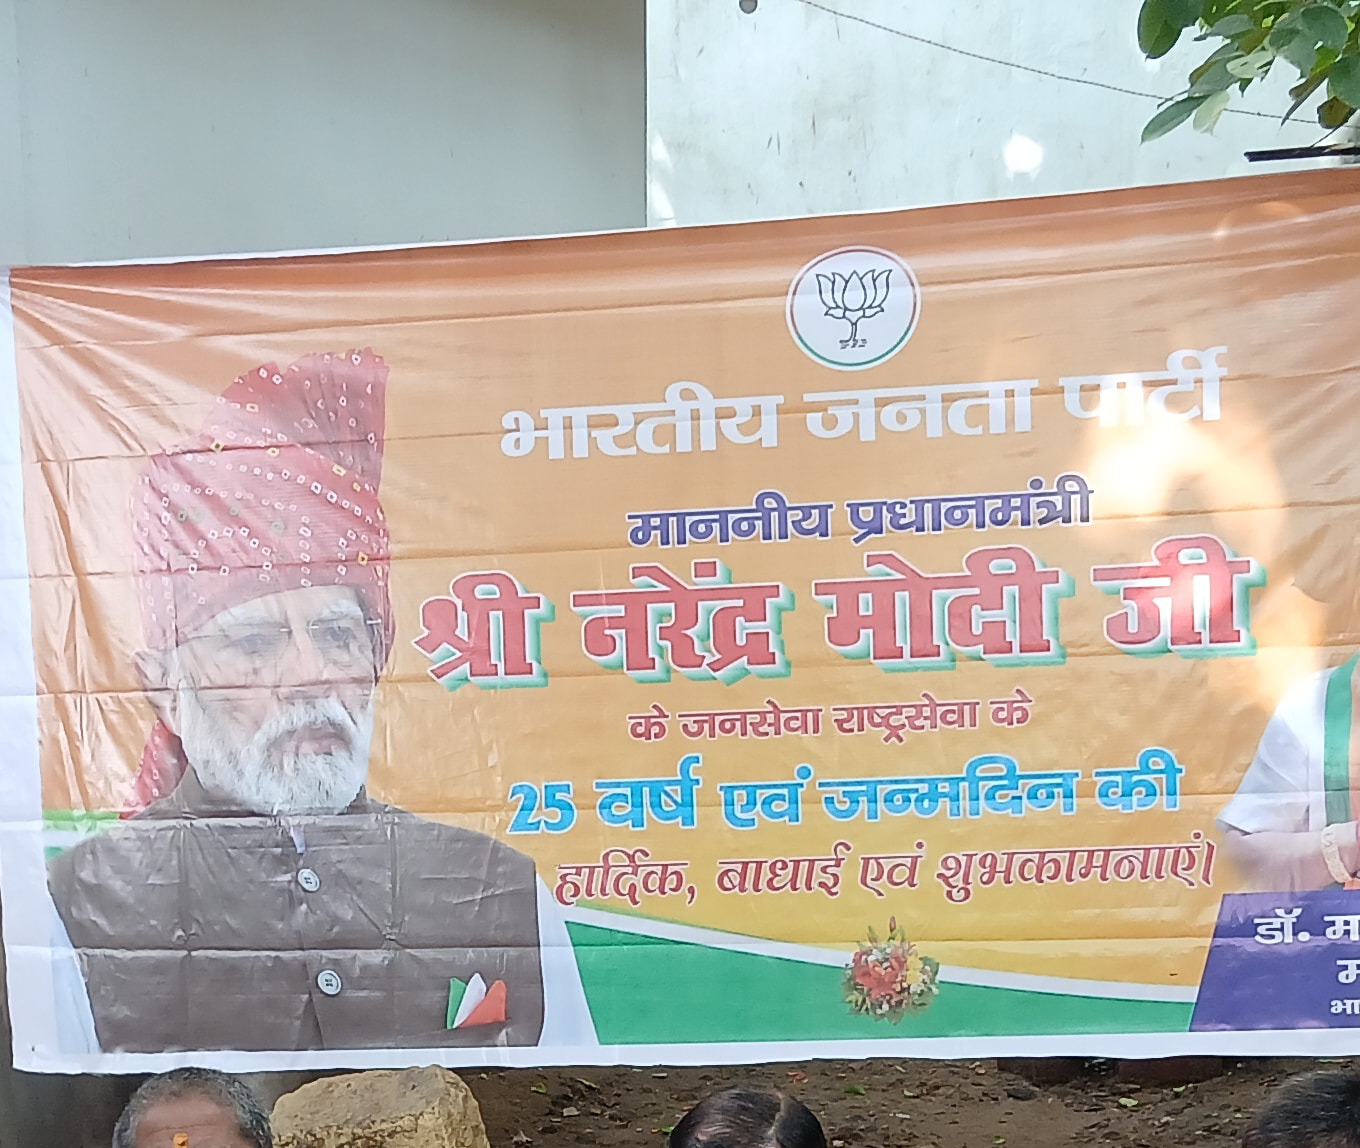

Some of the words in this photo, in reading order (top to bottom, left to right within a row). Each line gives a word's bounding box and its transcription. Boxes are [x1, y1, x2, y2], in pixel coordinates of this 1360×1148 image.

[499, 381, 784, 462] भारतीय
[805, 377, 1039, 444] जनता
[1059, 345, 1230, 428] पार्टी
[627, 491, 834, 549] माननीय
[846, 473, 1097, 545] प्रधानमंत्री
[413, 569, 551, 688] श्री
[571, 558, 792, 682] नरेंद्र
[813, 544, 1072, 674] मोदी
[1092, 534, 1267, 657] जी
[627, 702, 670, 743] के
[678, 698, 823, 740] जनसेवा
[832, 692, 981, 745] राष्ट्रसेवा
[989, 688, 1033, 727] के
[507, 780, 576, 836] 25
[595, 755, 703, 831] वर्ष
[718, 764, 816, 830] एवं
[817, 755, 1081, 824] जन्मदिन
[1095, 747, 1187, 815] की
[554, 848, 696, 907] हार्दिक,
[716, 842, 852, 898] बाधाई
[858, 841, 926, 897] एवं
[936, 831, 1215, 904] शुभकामनाएं।
[1253, 907, 1310, 946] डॉ.
